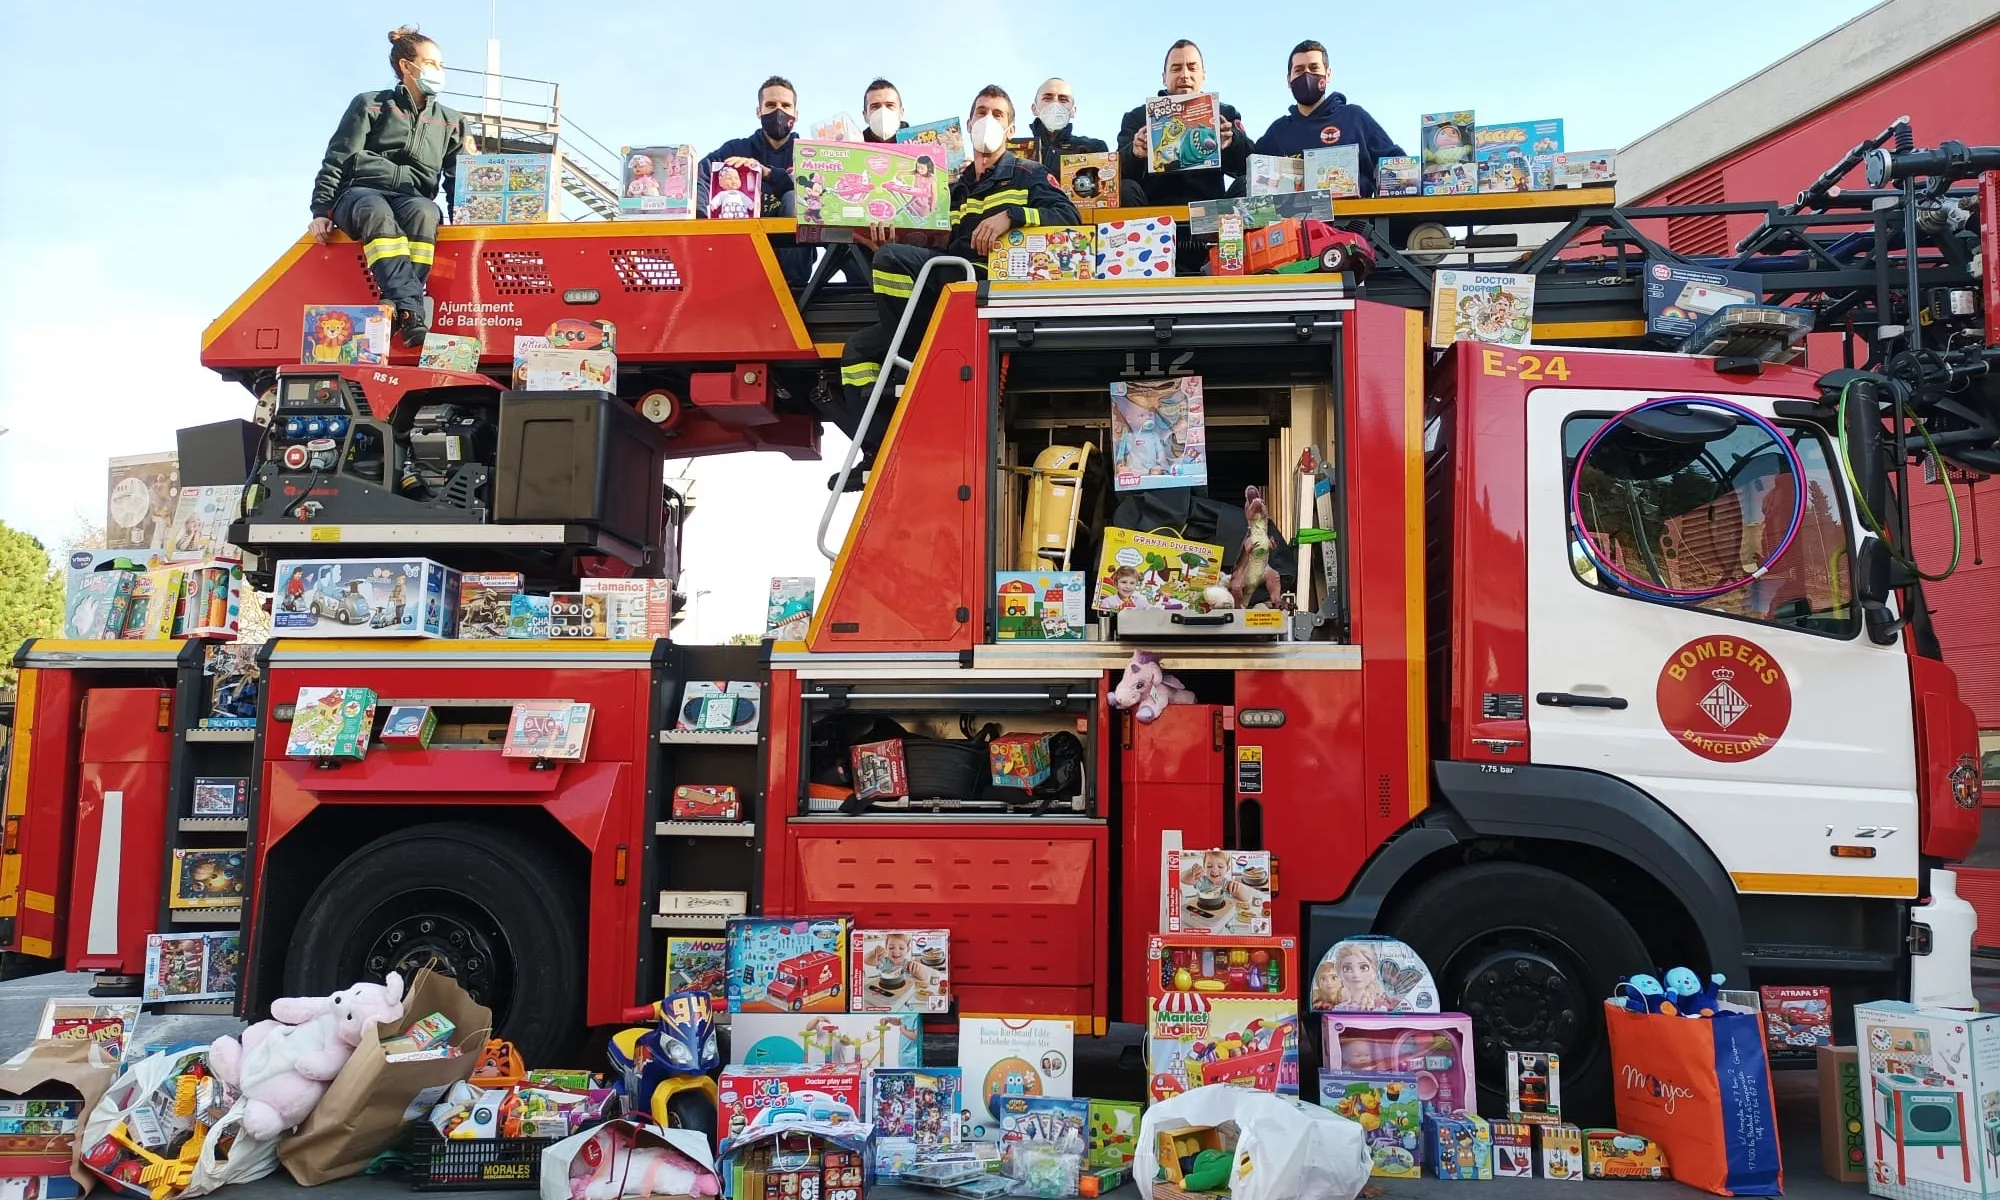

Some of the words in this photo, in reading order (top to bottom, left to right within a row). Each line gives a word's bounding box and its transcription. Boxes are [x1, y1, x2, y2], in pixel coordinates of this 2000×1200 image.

[801, 160, 844, 171] MINNIE
[1475, 276, 1516, 285] DOCTOR
[438, 301, 514, 314] Ajuntament
[438, 316, 454, 326] de
[457, 315, 523, 327] Barcelona
[1482, 349, 1571, 381] E-24
[373, 371, 388, 382] RS
[388, 376, 399, 386] 14
[1120, 476, 1140, 485] BABY
[1133, 535, 1168, 548] GRANJA
[1170, 542, 1213, 556] DIVERTIDA
[598, 581, 643, 592] tamaños
[532, 616, 549, 626] CHA
[532, 626, 549, 636] CHO
[1667, 640, 1779, 685] BOMBERS
[1682, 729, 1769, 755] BARCELONA
[1500, 765, 1514, 774] bar
[1812, 989, 1819, 997] 5
[1157, 1011, 1208, 1023] Market
[1160, 1023, 1206, 1039] Trolley
[827, 1078, 840, 1086] play
[1746, 1075, 1756, 1084] 21
[753, 1078, 790, 1097] Kids
[1325, 1086, 1346, 1095] Disney
[1752, 1110, 1761, 1124] 972
[1747, 1149, 1757, 1170] 17100
[483, 1164, 531, 1175] MORALES
